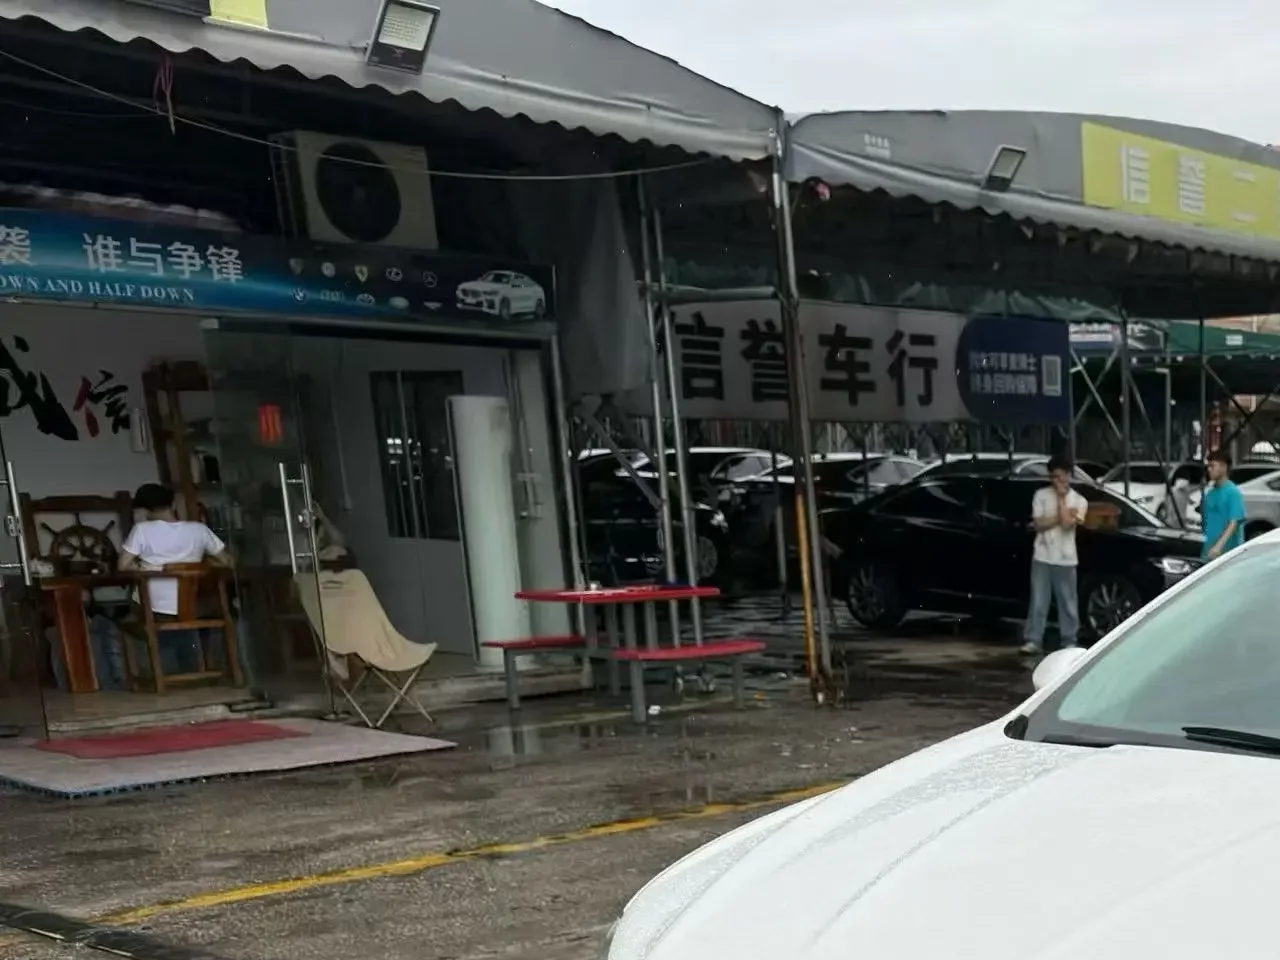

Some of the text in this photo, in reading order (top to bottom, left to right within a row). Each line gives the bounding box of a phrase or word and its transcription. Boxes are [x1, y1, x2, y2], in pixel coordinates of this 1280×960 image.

[82, 231, 244, 285] 谁与争锋
[44, 278, 84, 295] AND
[88, 281, 135, 298] HALF
[140, 285, 196, 301] DOWN
[656, 311, 939, 407] 信誉车行
